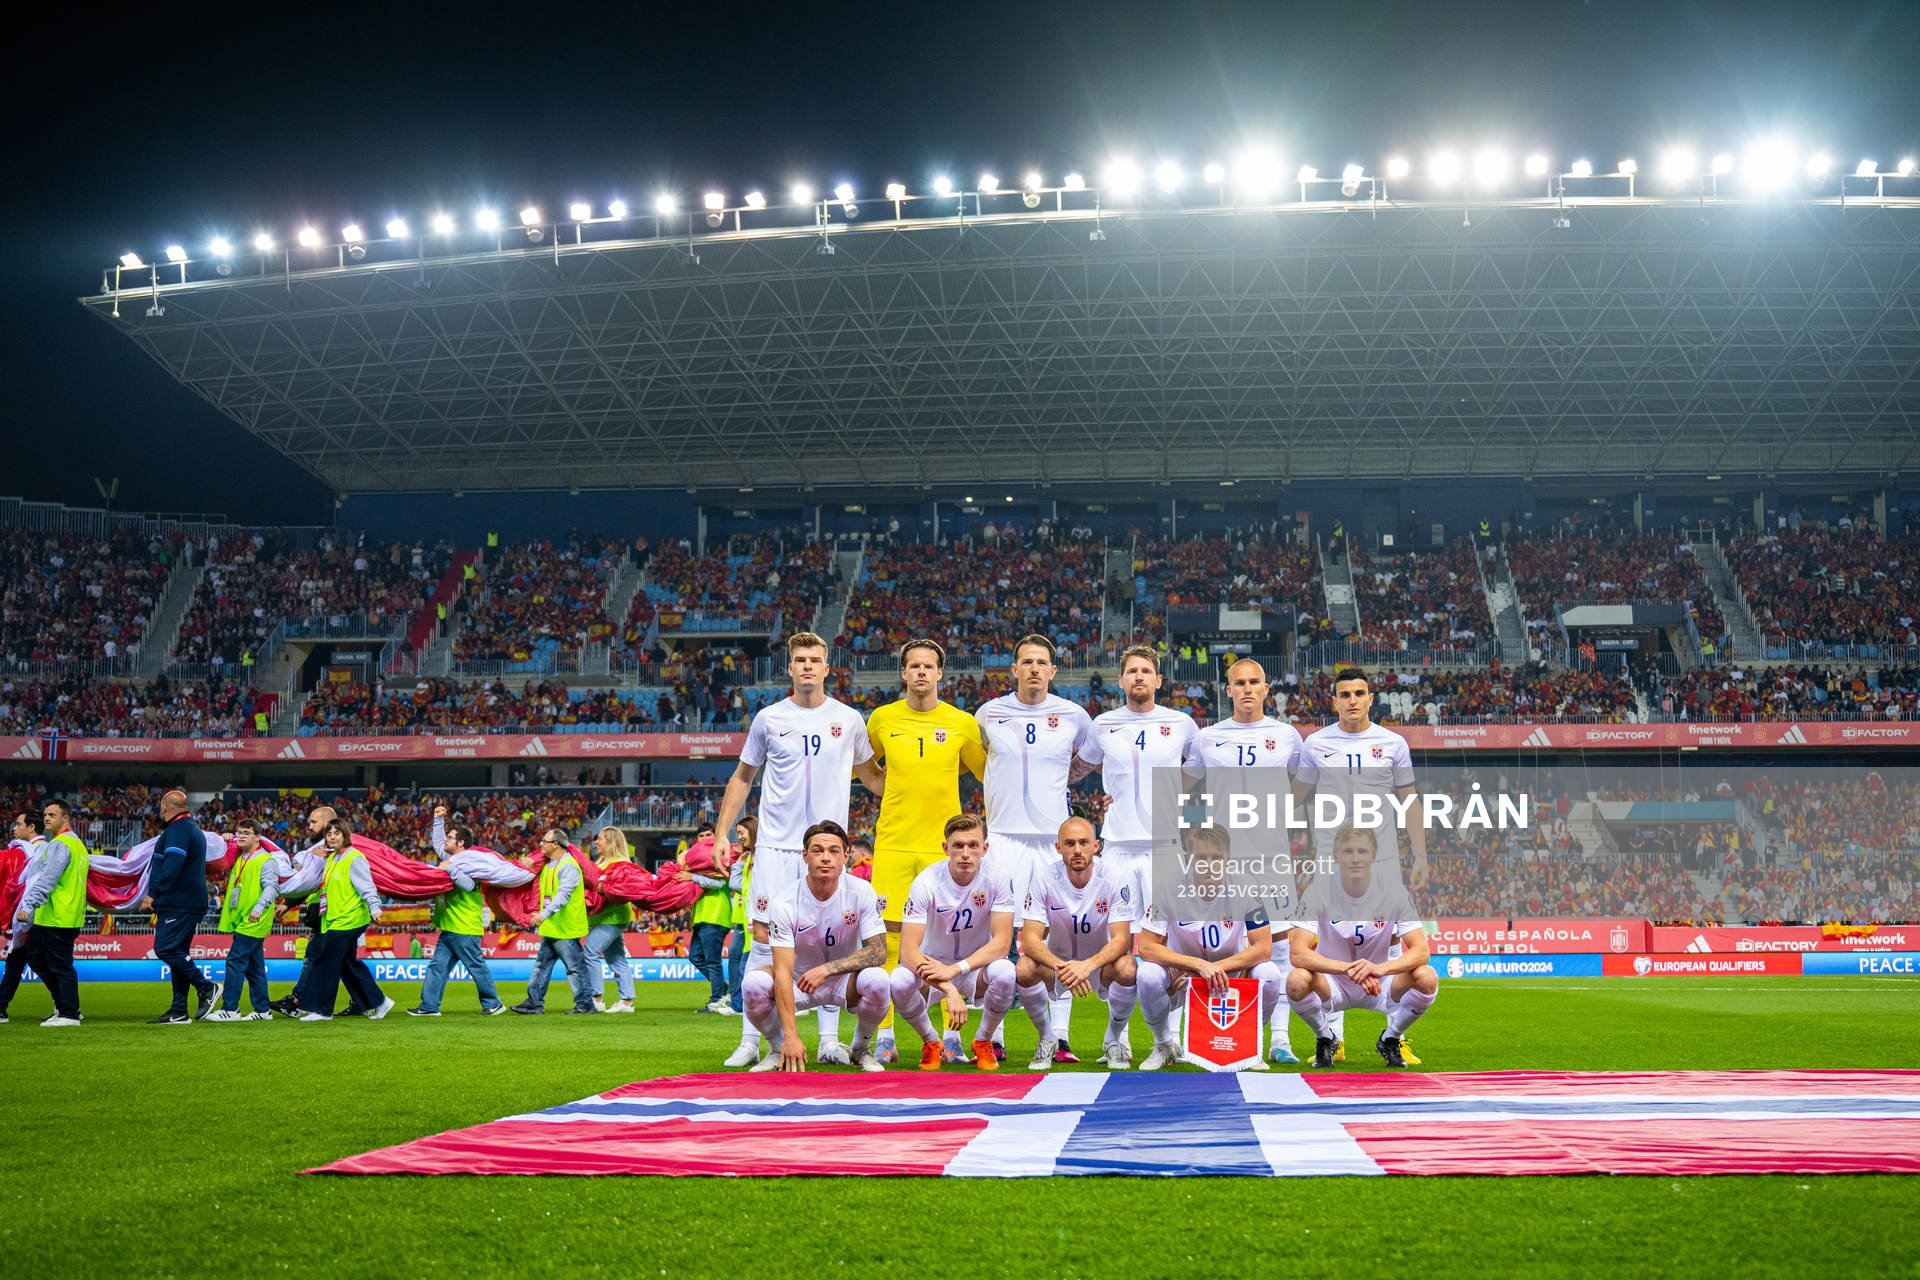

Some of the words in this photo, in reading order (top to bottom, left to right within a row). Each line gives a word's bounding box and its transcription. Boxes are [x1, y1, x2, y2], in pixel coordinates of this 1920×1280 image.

[1026, 723, 1036, 744] 8
[1433, 727, 1487, 737] finetwork
[1688, 724, 1742, 734] finetwork
[194, 739, 245, 748] finetwork
[435, 737, 486, 746] finetwork
[680, 735, 732, 744] finetwork
[802, 734, 821, 756] 19
[918, 737, 924, 757] 1
[1135, 730, 1146, 751] 4
[1237, 745, 1257, 767] 15
[1346, 753, 1361, 775] 11
[950, 908, 973, 933] 22
[1072, 914, 1092, 935] 16
[1253, 911, 1264, 925] C
[824, 927, 835, 947] 6
[1201, 926, 1220, 950] 10
[1354, 925, 1365, 946] 5
[1431, 928, 1487, 941] CCIÓN
[1495, 927, 1593, 941] ESPAÑOLA
[74, 940, 122, 951] etwork
[1437, 944, 1460, 954] DE
[1469, 941, 1540, 954] FÚTBOL
[376, 964, 425, 979] PEACE
[1653, 961, 1706, 972] EUROPEAN
[1709, 960, 1766, 971] QUALIFIERS
[1859, 957, 1915, 973] PEACE
